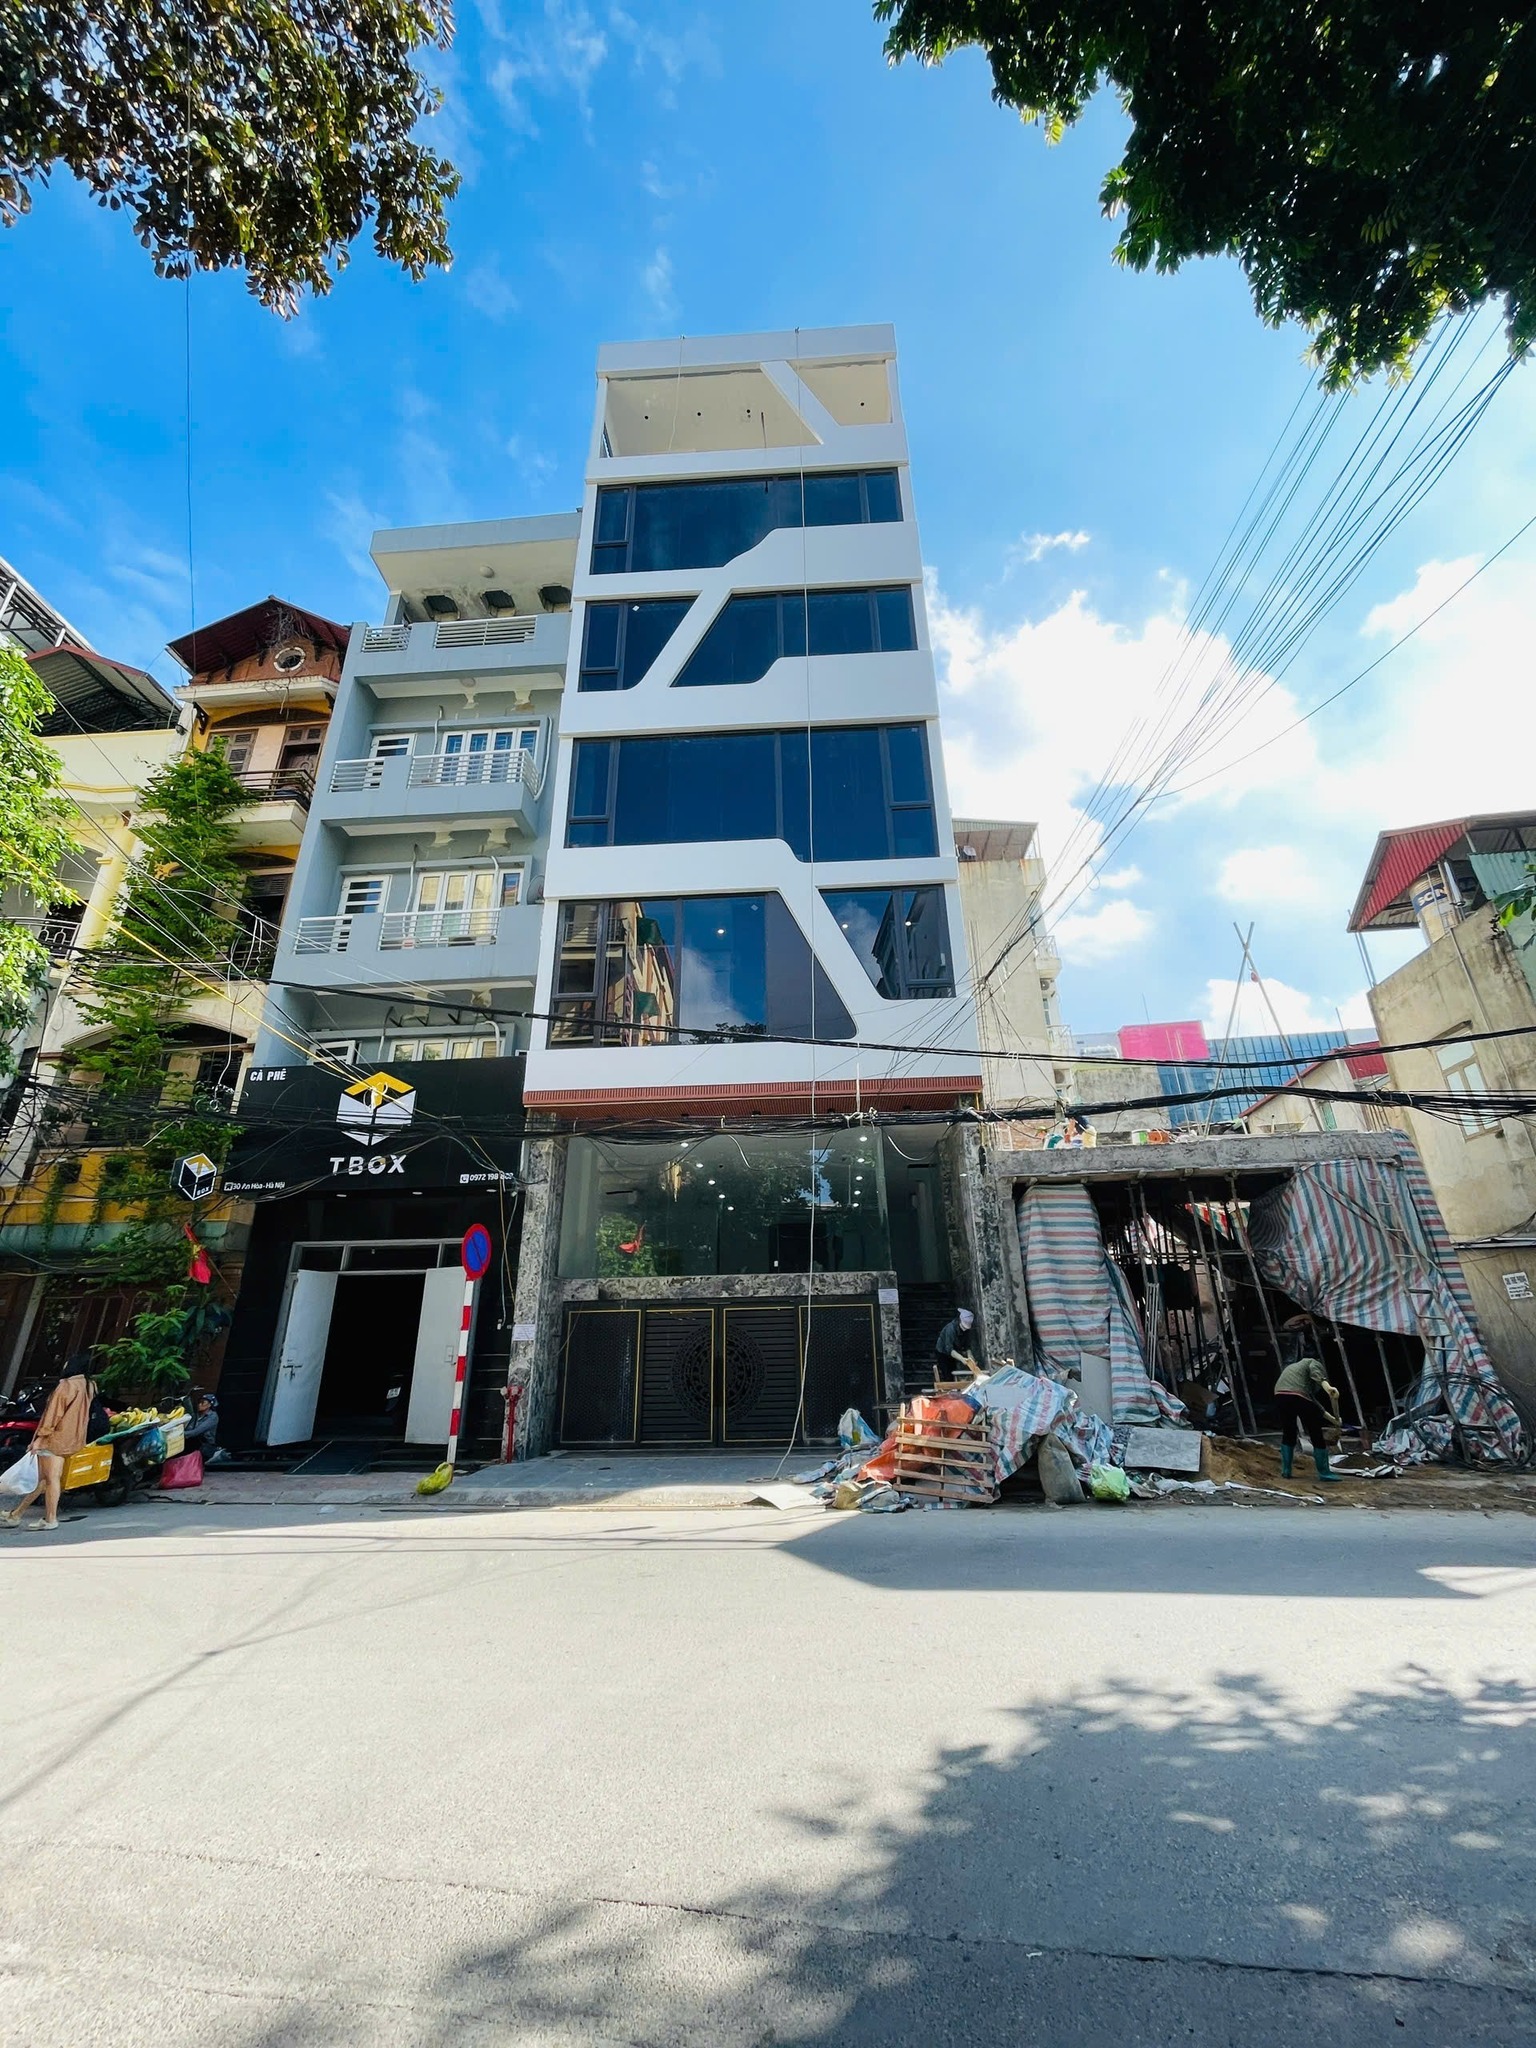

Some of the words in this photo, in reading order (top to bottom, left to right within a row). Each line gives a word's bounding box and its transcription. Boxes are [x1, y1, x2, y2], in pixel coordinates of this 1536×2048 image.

[250, 1069, 263, 1082] CÀ
[266, 1067, 287, 1081] PHÊ
[329, 1154, 407, 1176] TBOX
[470, 1173, 487, 1182] 0972
[487, 1172, 499, 1181] 198
